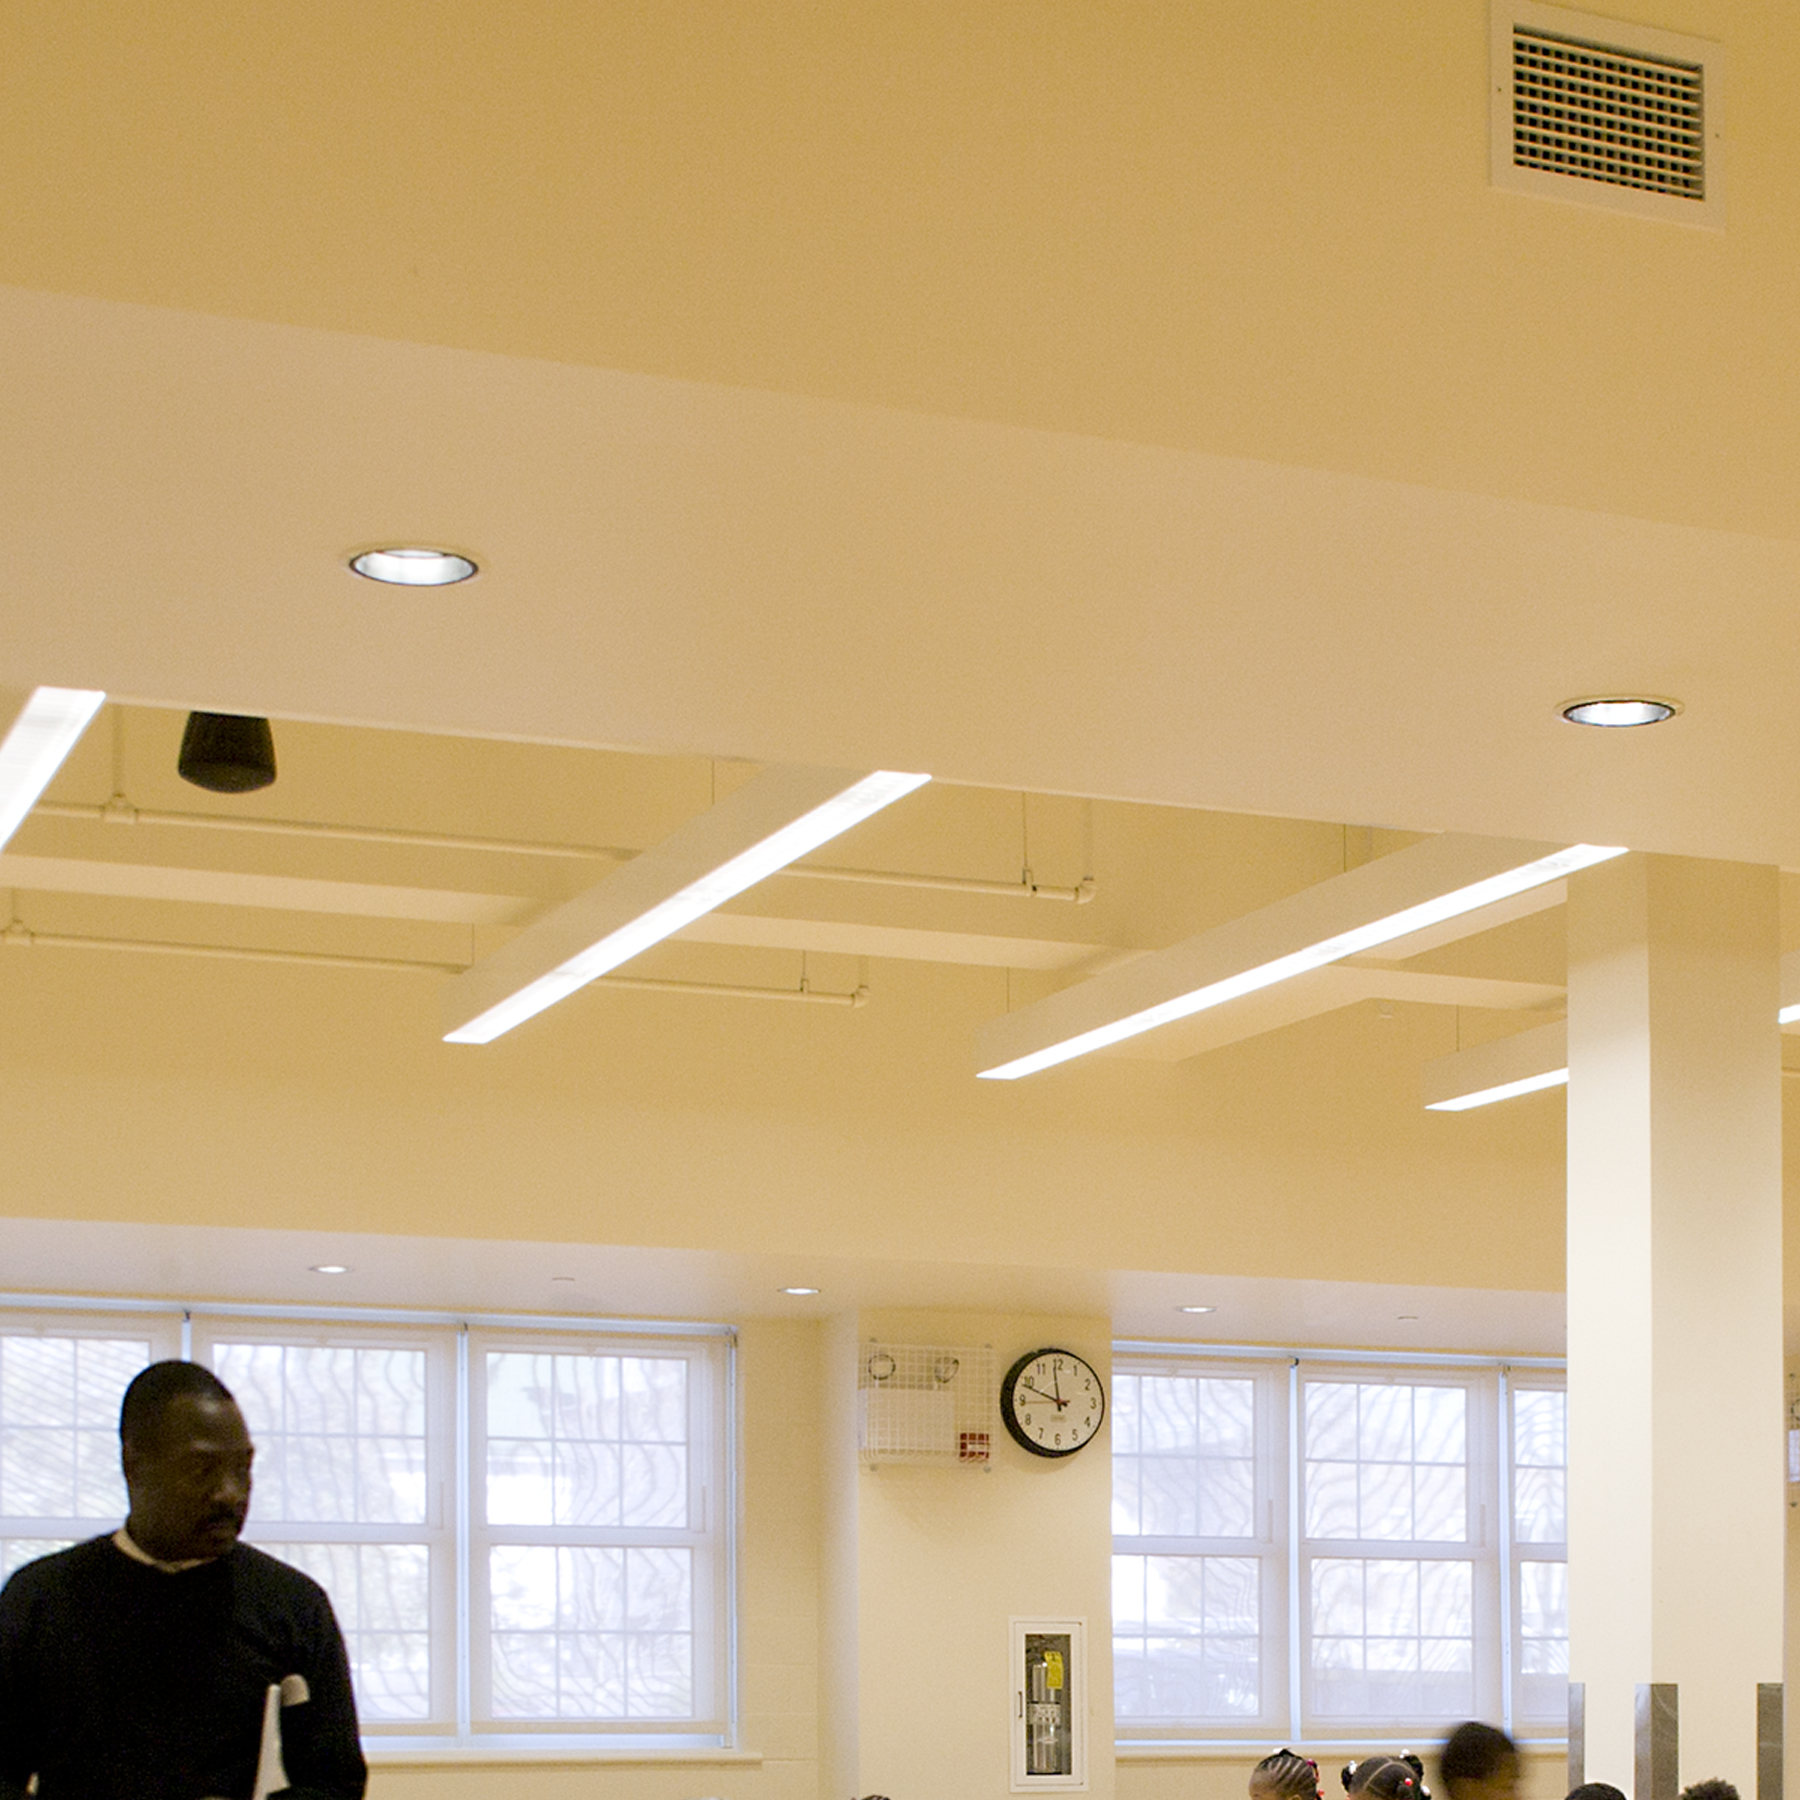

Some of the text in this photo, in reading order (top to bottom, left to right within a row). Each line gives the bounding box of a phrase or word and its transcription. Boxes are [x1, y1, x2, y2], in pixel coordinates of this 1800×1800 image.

[1036, 1363, 1046, 1375] 11
[1052, 1358, 1064, 1371] 12
[1073, 1365, 1078, 1376] 1
[1024, 1376, 1034, 1389] 10
[1084, 1378, 1091, 1391] 2
[1019, 1394, 1026, 1407] 9
[1090, 1397, 1097, 1409] 3
[1025, 1413, 1031, 1425] 8
[1084, 1416, 1090, 1427] 4
[1039, 1427, 1044, 1440] 7
[1055, 1433, 1061, 1446] 6
[1072, 1429, 1078, 1441] 5
